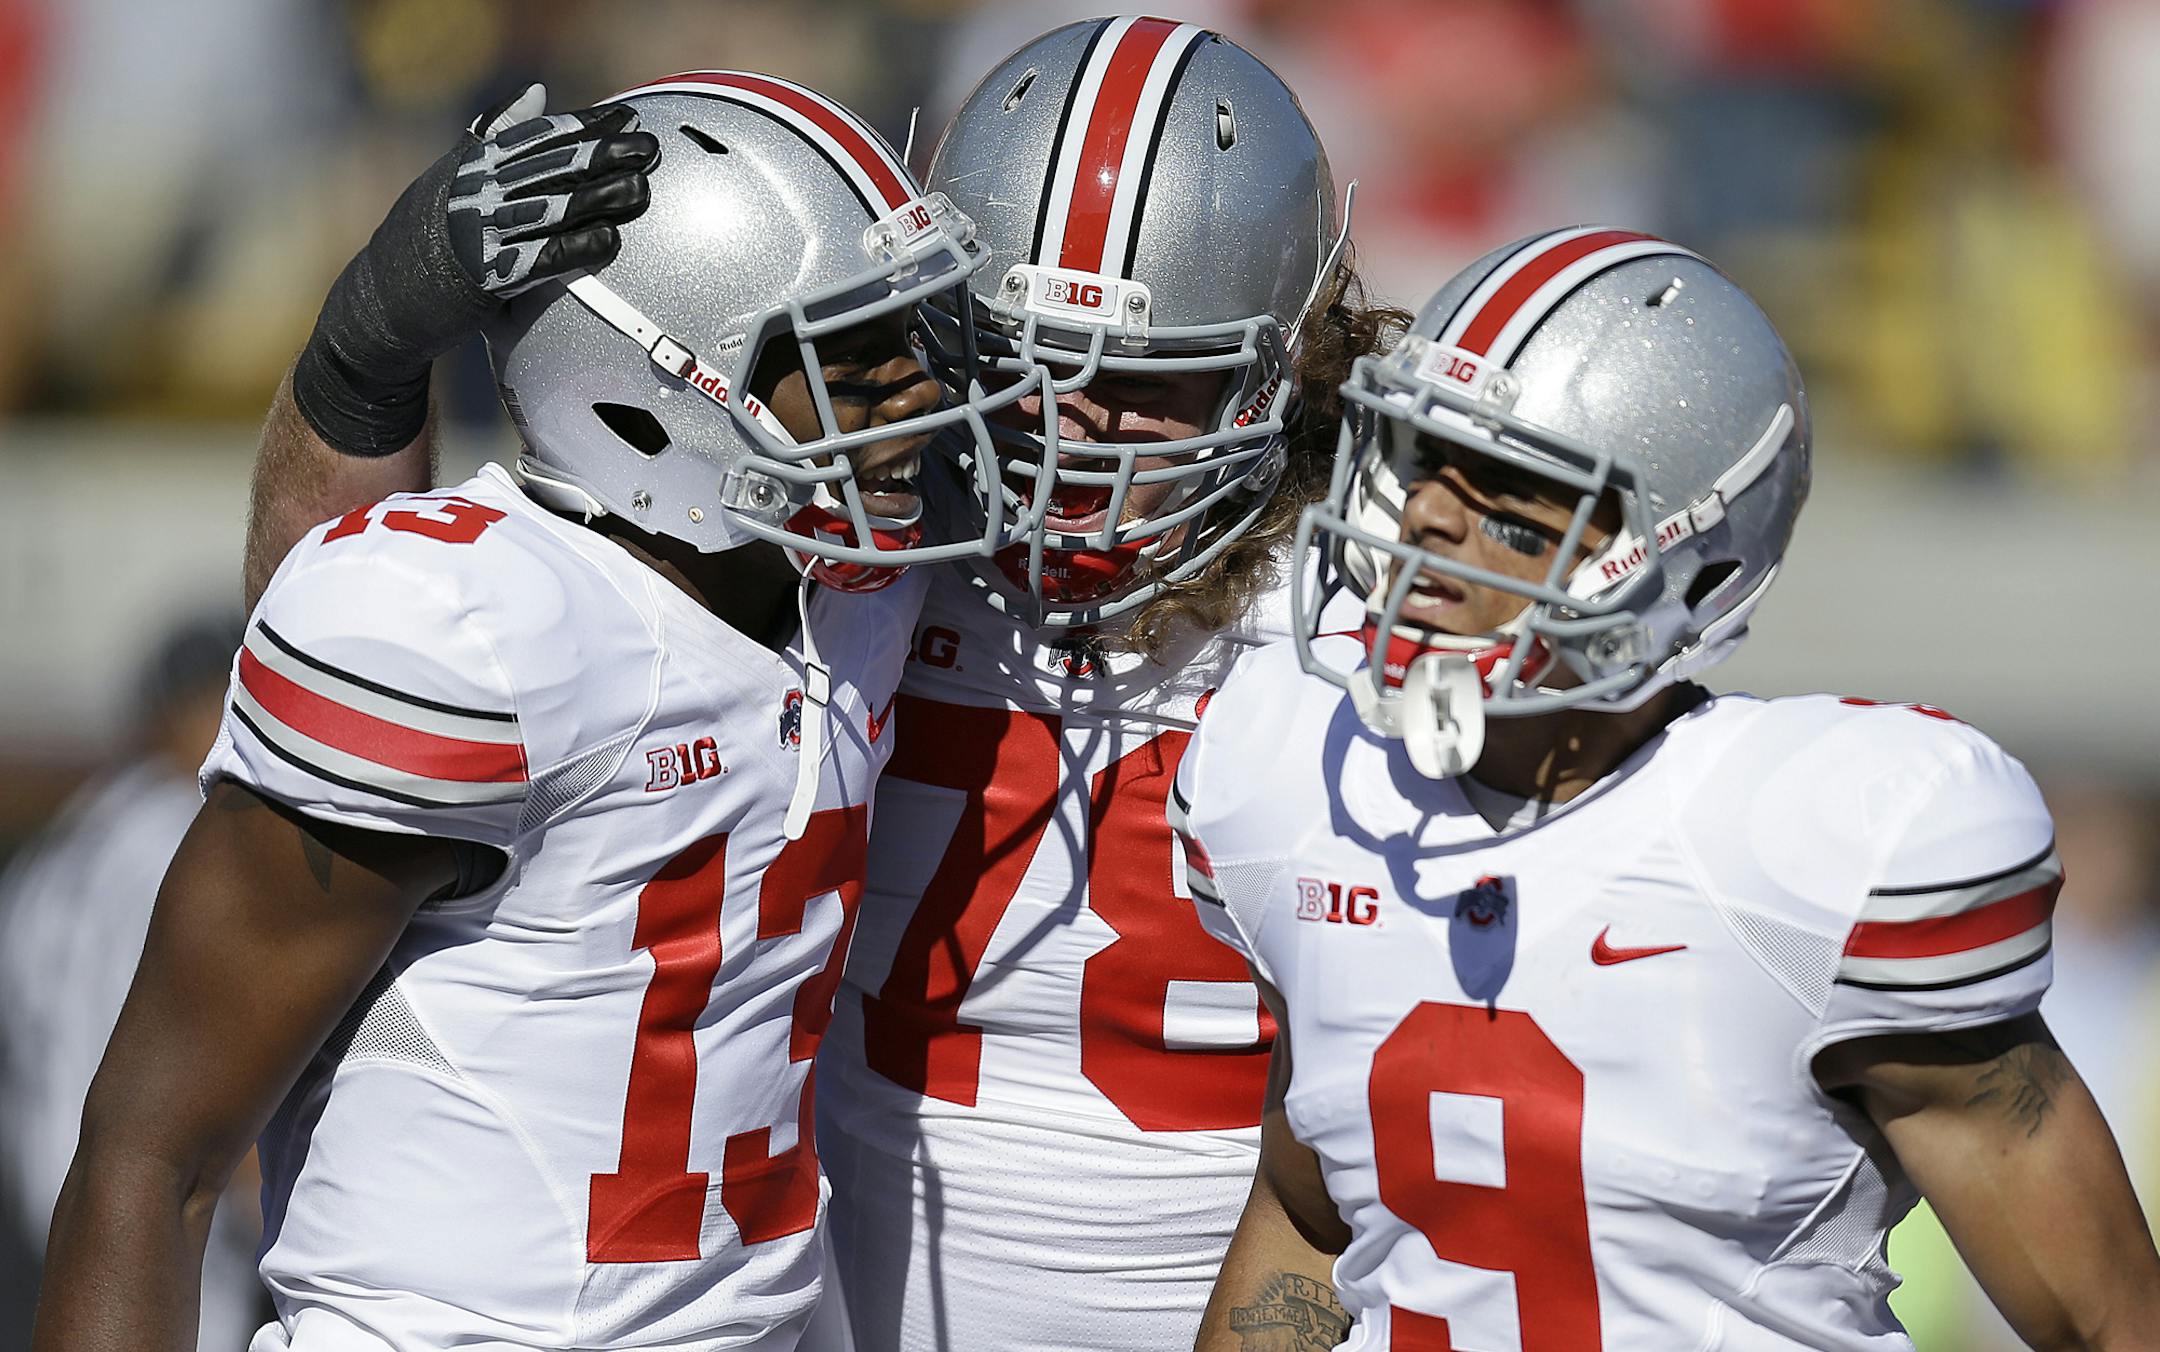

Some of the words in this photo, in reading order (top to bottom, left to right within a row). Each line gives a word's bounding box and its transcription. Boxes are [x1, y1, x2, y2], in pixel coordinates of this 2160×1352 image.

[679, 359, 761, 418] Riddll
[320, 495, 508, 547] 13
[1018, 557, 1068, 579] Rdell
[862, 692, 1278, 1132] 78
[587, 803, 868, 1264] 13
[1368, 1000, 1603, 1352] 9
